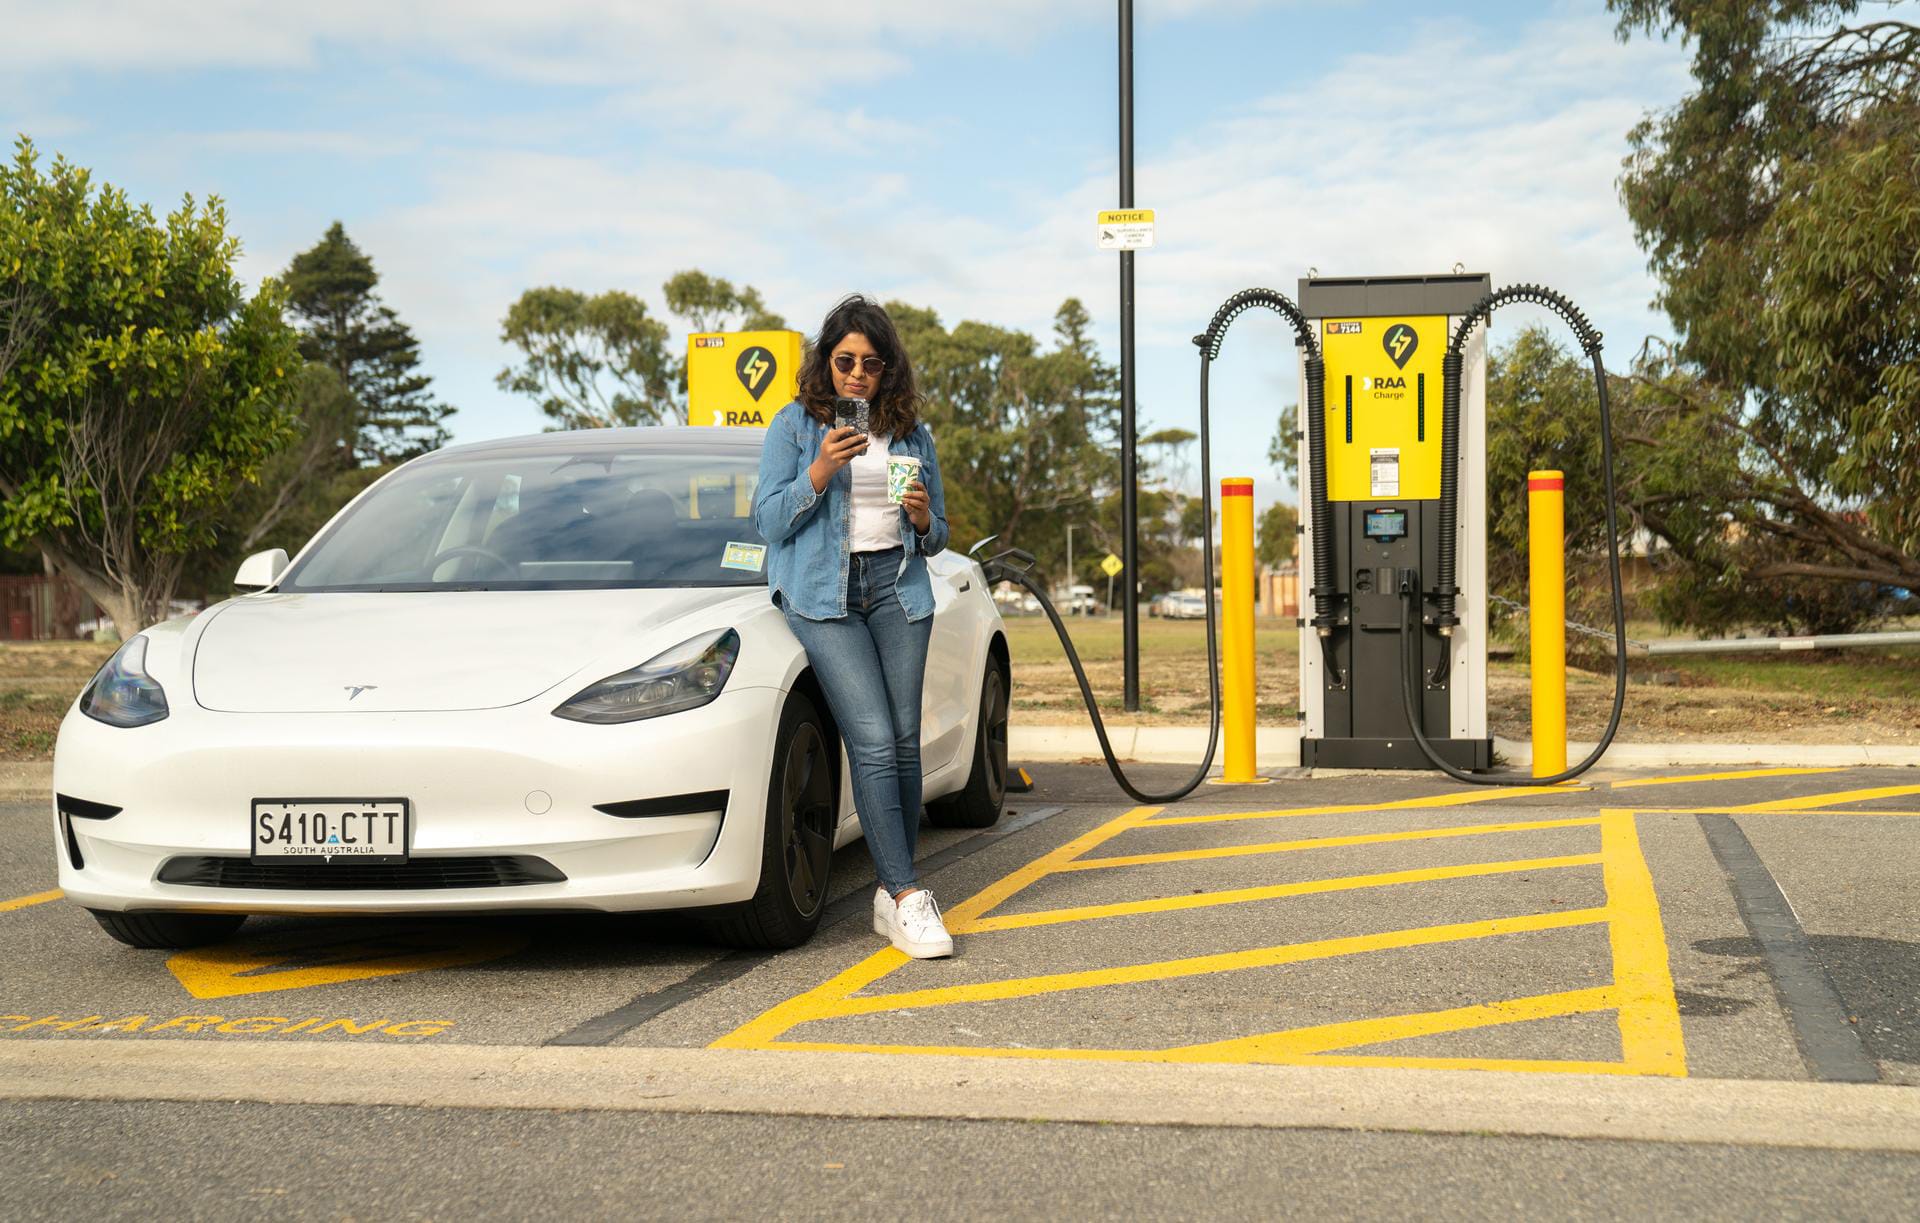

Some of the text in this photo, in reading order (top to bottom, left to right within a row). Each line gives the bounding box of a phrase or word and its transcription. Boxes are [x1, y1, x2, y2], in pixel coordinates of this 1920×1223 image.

[1108, 213, 1144, 222] NOTICE
[1341, 325, 1360, 334] 7144
[1374, 377, 1406, 389] RAA
[1373, 391, 1404, 400] Charge
[726, 410, 764, 425] RAA
[259, 812, 399, 844] S410 CTT
[283, 846, 375, 854] SOUTH AUSTRALIA
